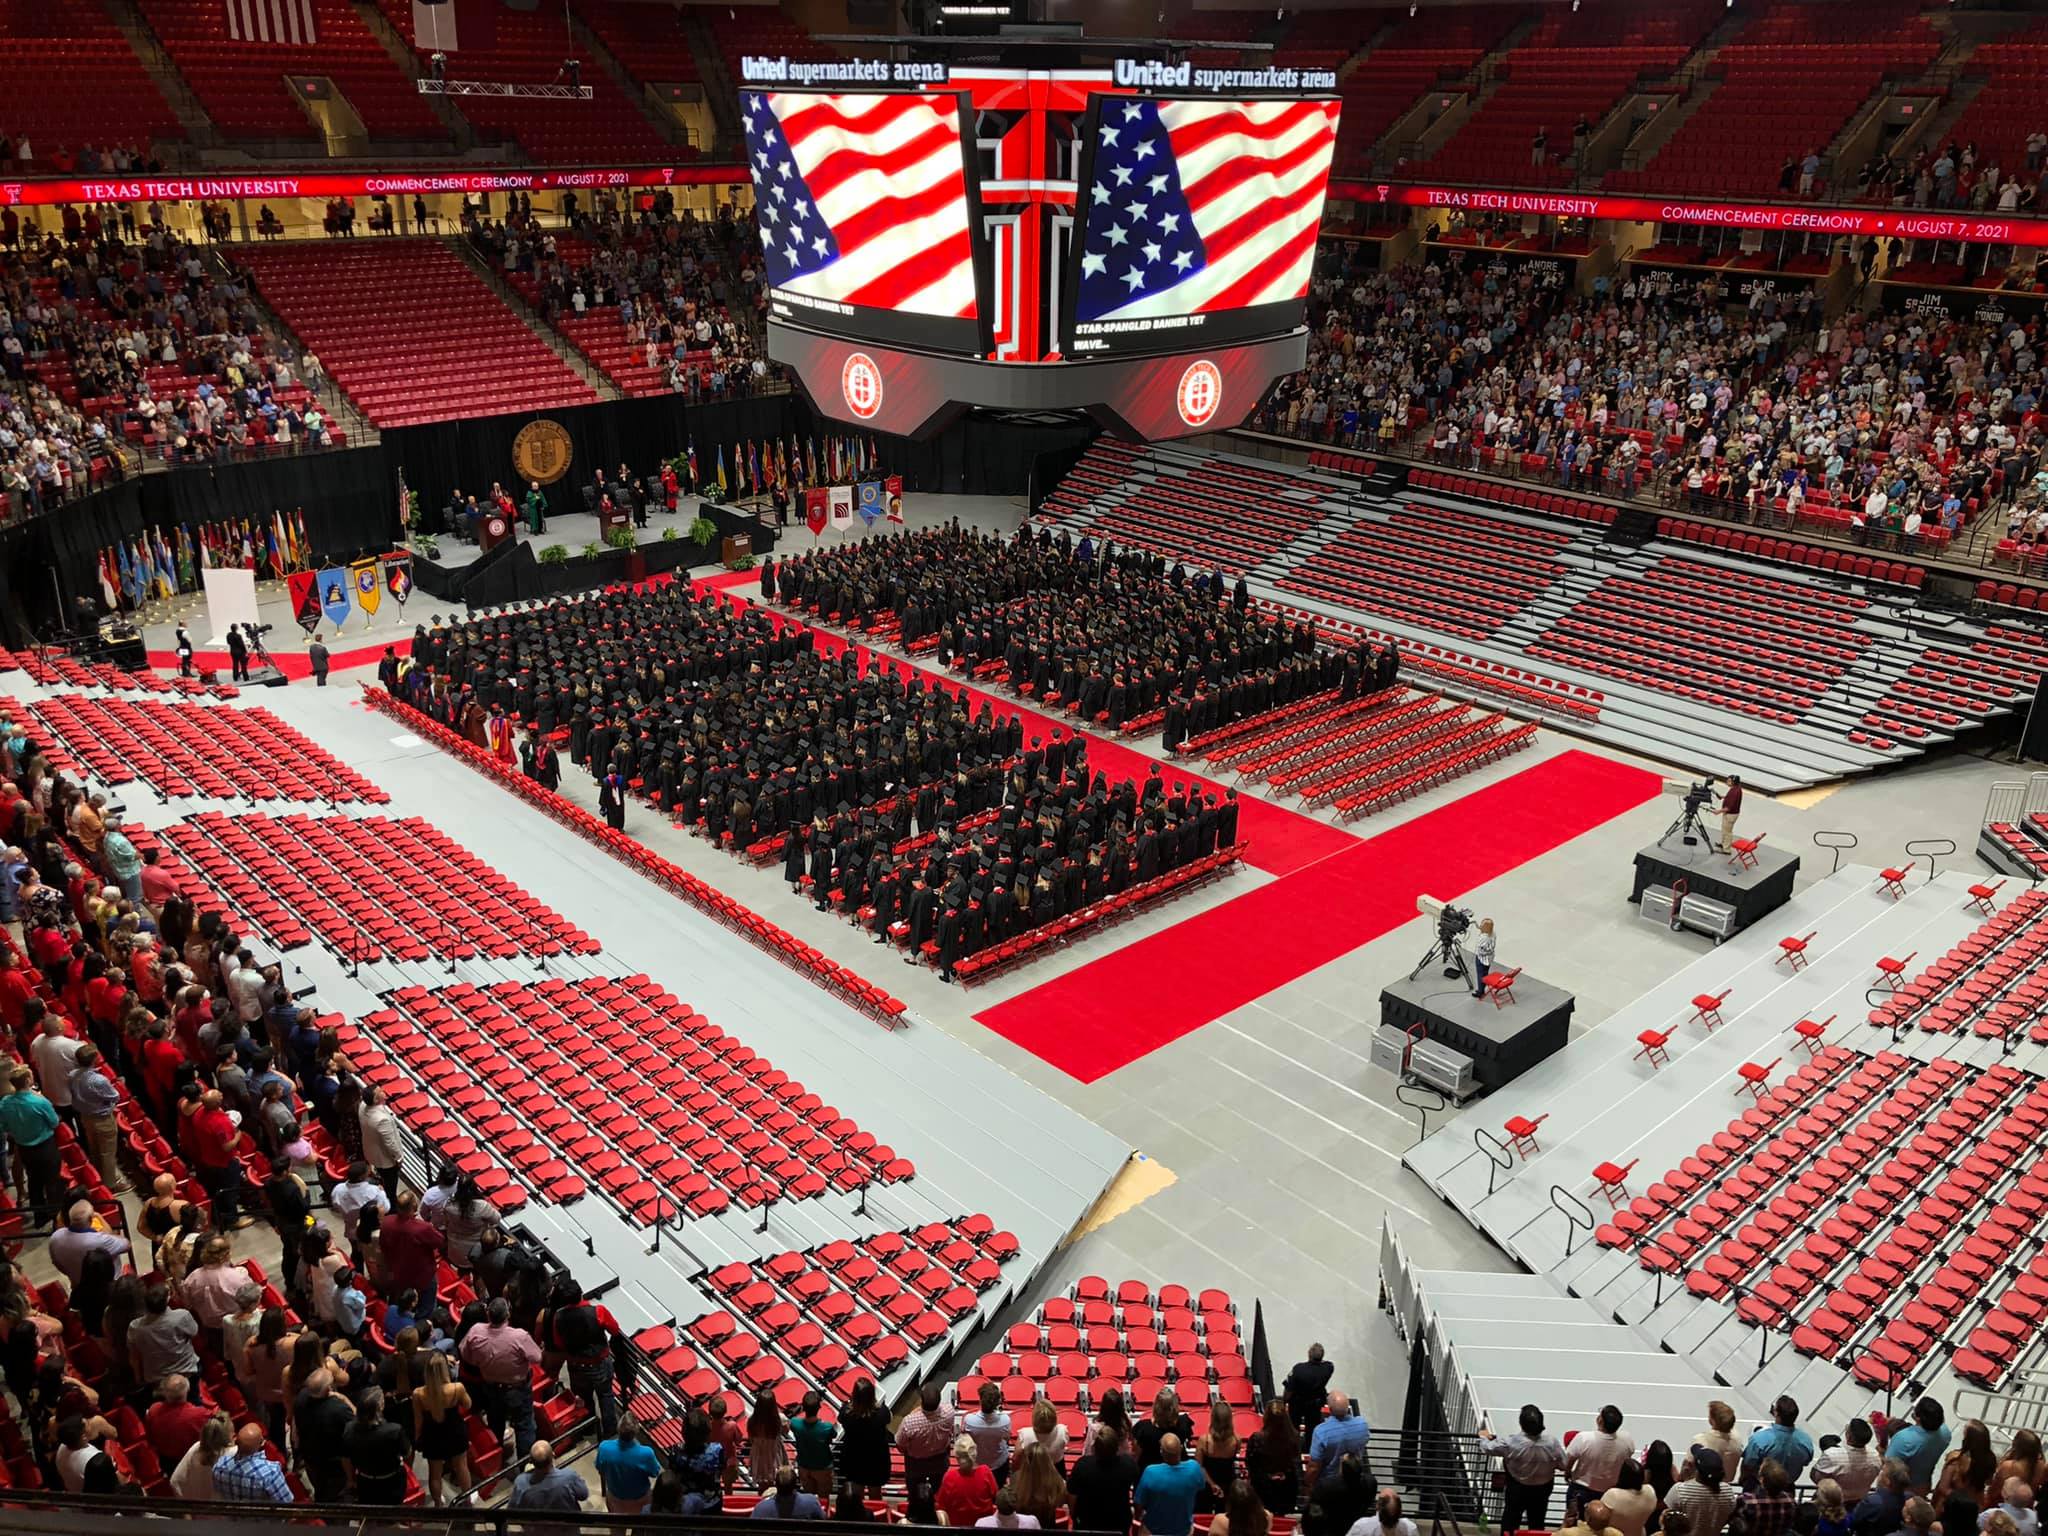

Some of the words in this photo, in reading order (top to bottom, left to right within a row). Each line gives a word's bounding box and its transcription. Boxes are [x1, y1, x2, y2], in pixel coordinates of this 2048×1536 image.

[741, 56, 788, 80] United
[789, 57, 889, 85] supermarkets
[893, 62, 945, 81] arena
[1114, 59, 1191, 87] United
[1194, 65, 1299, 92] supermarkets
[1301, 69, 1336, 88] arena
[82, 183, 141, 199] TEXAS
[145, 182, 194, 198] TECH
[198, 180, 299, 196] UNIVERSITY
[365, 177, 468, 191] COMMENCEMENT
[471, 176, 533, 189] CEREMONY
[557, 174, 595, 185] AUGUST
[608, 172, 629, 184] 2021
[1427, 191, 1469, 205] TEXAS
[1471, 193, 1508, 208] TECH
[1512, 196, 1599, 214] UNIVERSITY
[1662, 206, 1778, 225] COMMENCEMENT
[1782, 213, 1864, 229] CEREMONY
[1896, 219, 1954, 235] AUGUST
[1957, 223, 1970, 237] 7,
[1975, 224, 2009, 238] 2021
[1919, 293, 1942, 306] JIM
[1075, 319, 1152, 334] STAR-SPANGLED
[1152, 317, 1188, 329] BANNER
[1188, 314, 1206, 326] YET
